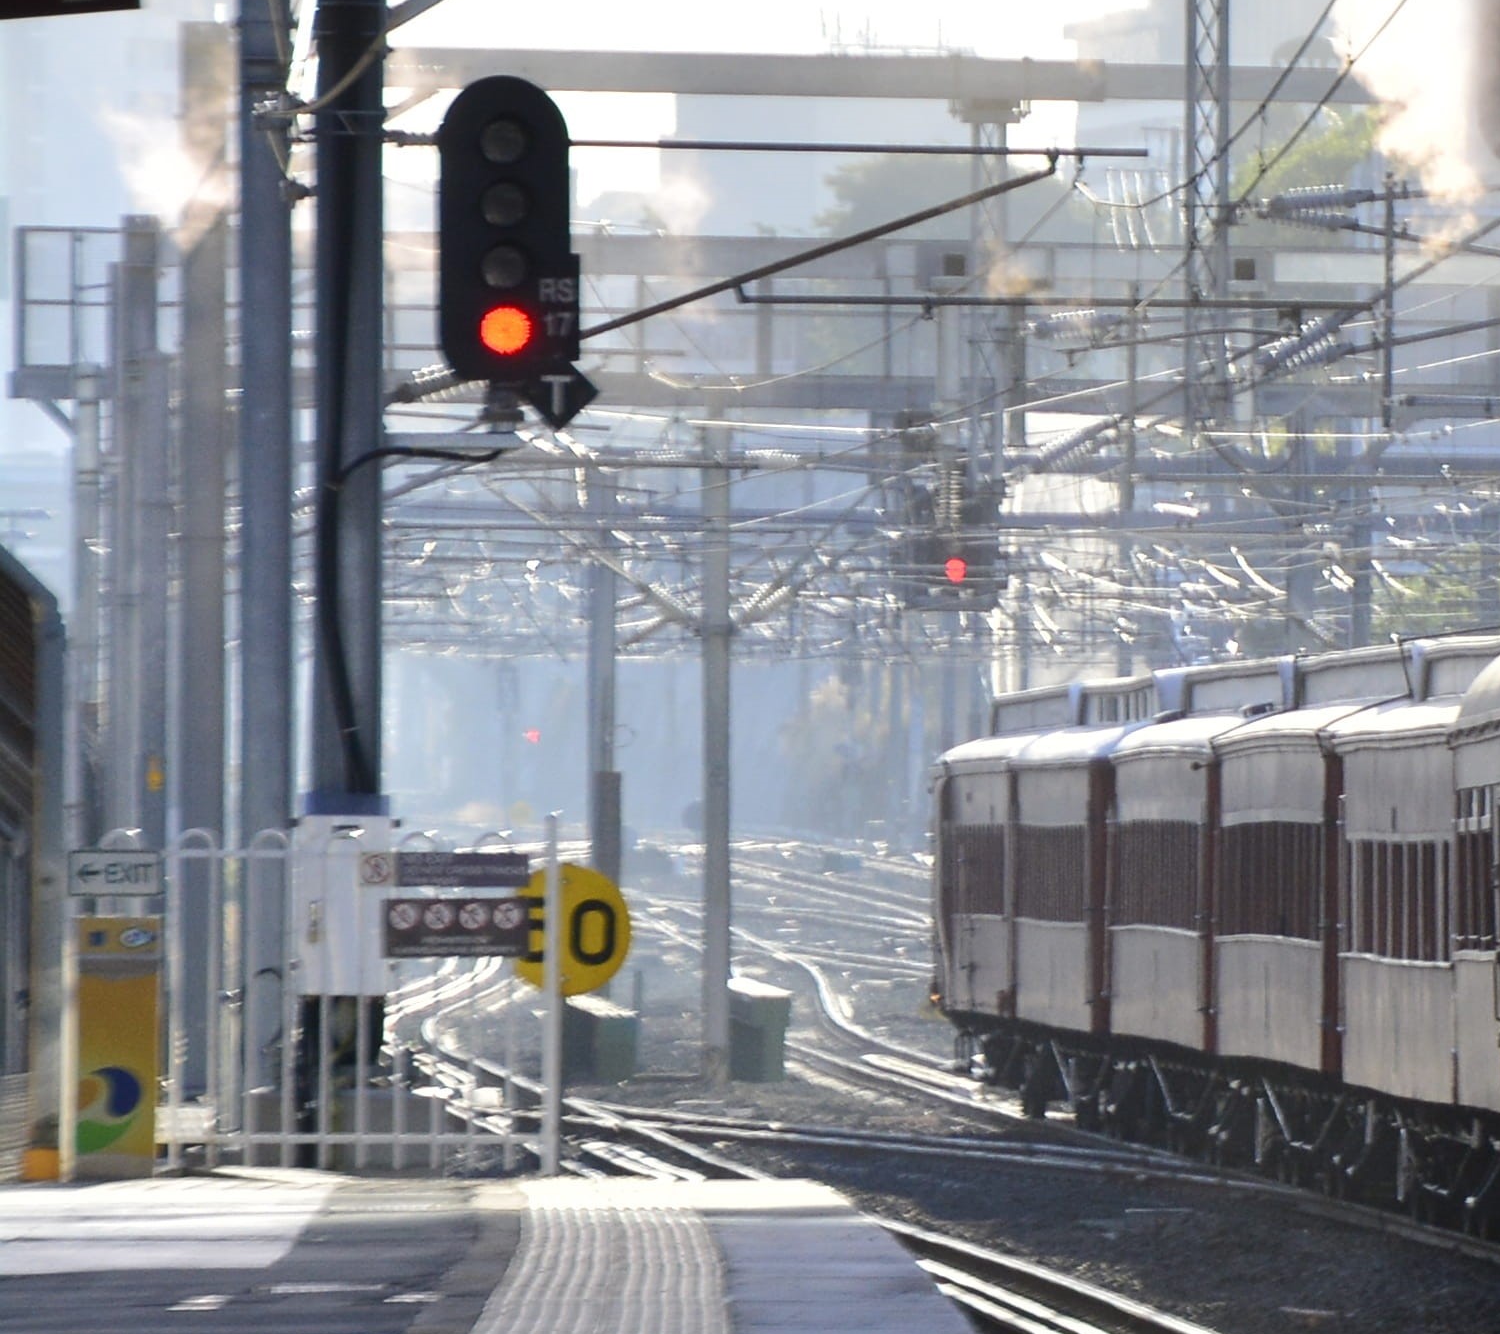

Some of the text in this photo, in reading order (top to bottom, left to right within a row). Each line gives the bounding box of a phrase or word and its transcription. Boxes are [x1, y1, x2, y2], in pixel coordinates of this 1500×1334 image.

[538, 278, 576, 303] RS
[543, 311, 573, 337] 17
[540, 374, 574, 416] T
[104, 863, 153, 883] EXIT
